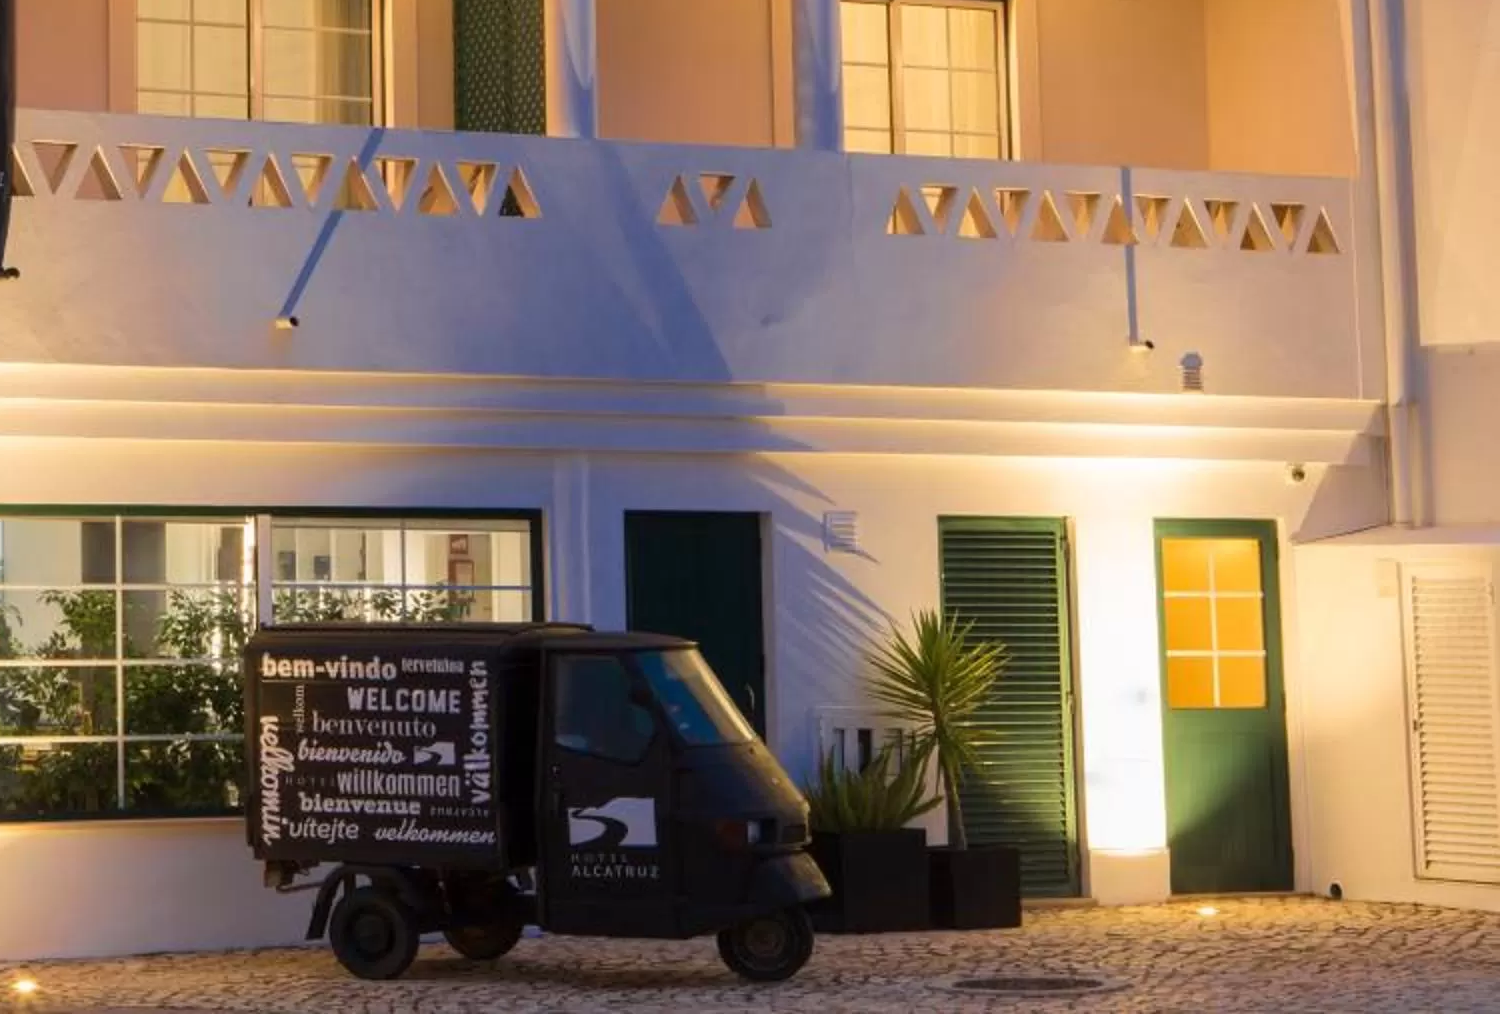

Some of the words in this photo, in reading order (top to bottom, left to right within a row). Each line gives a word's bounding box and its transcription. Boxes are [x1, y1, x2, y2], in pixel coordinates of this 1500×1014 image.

[261, 652, 397, 681] bem-vindo
[347, 687, 462, 714] WELCOME
[312, 710, 437, 738] benvenuto
[463, 660, 492, 804] välkommen
[297, 738, 407, 765] bienvenido
[337, 768, 461, 797] willkommen
[297, 791, 421, 815] bienvenue
[372, 817, 497, 845] velkommen
[571, 865, 661, 879] ALCATRUZ
